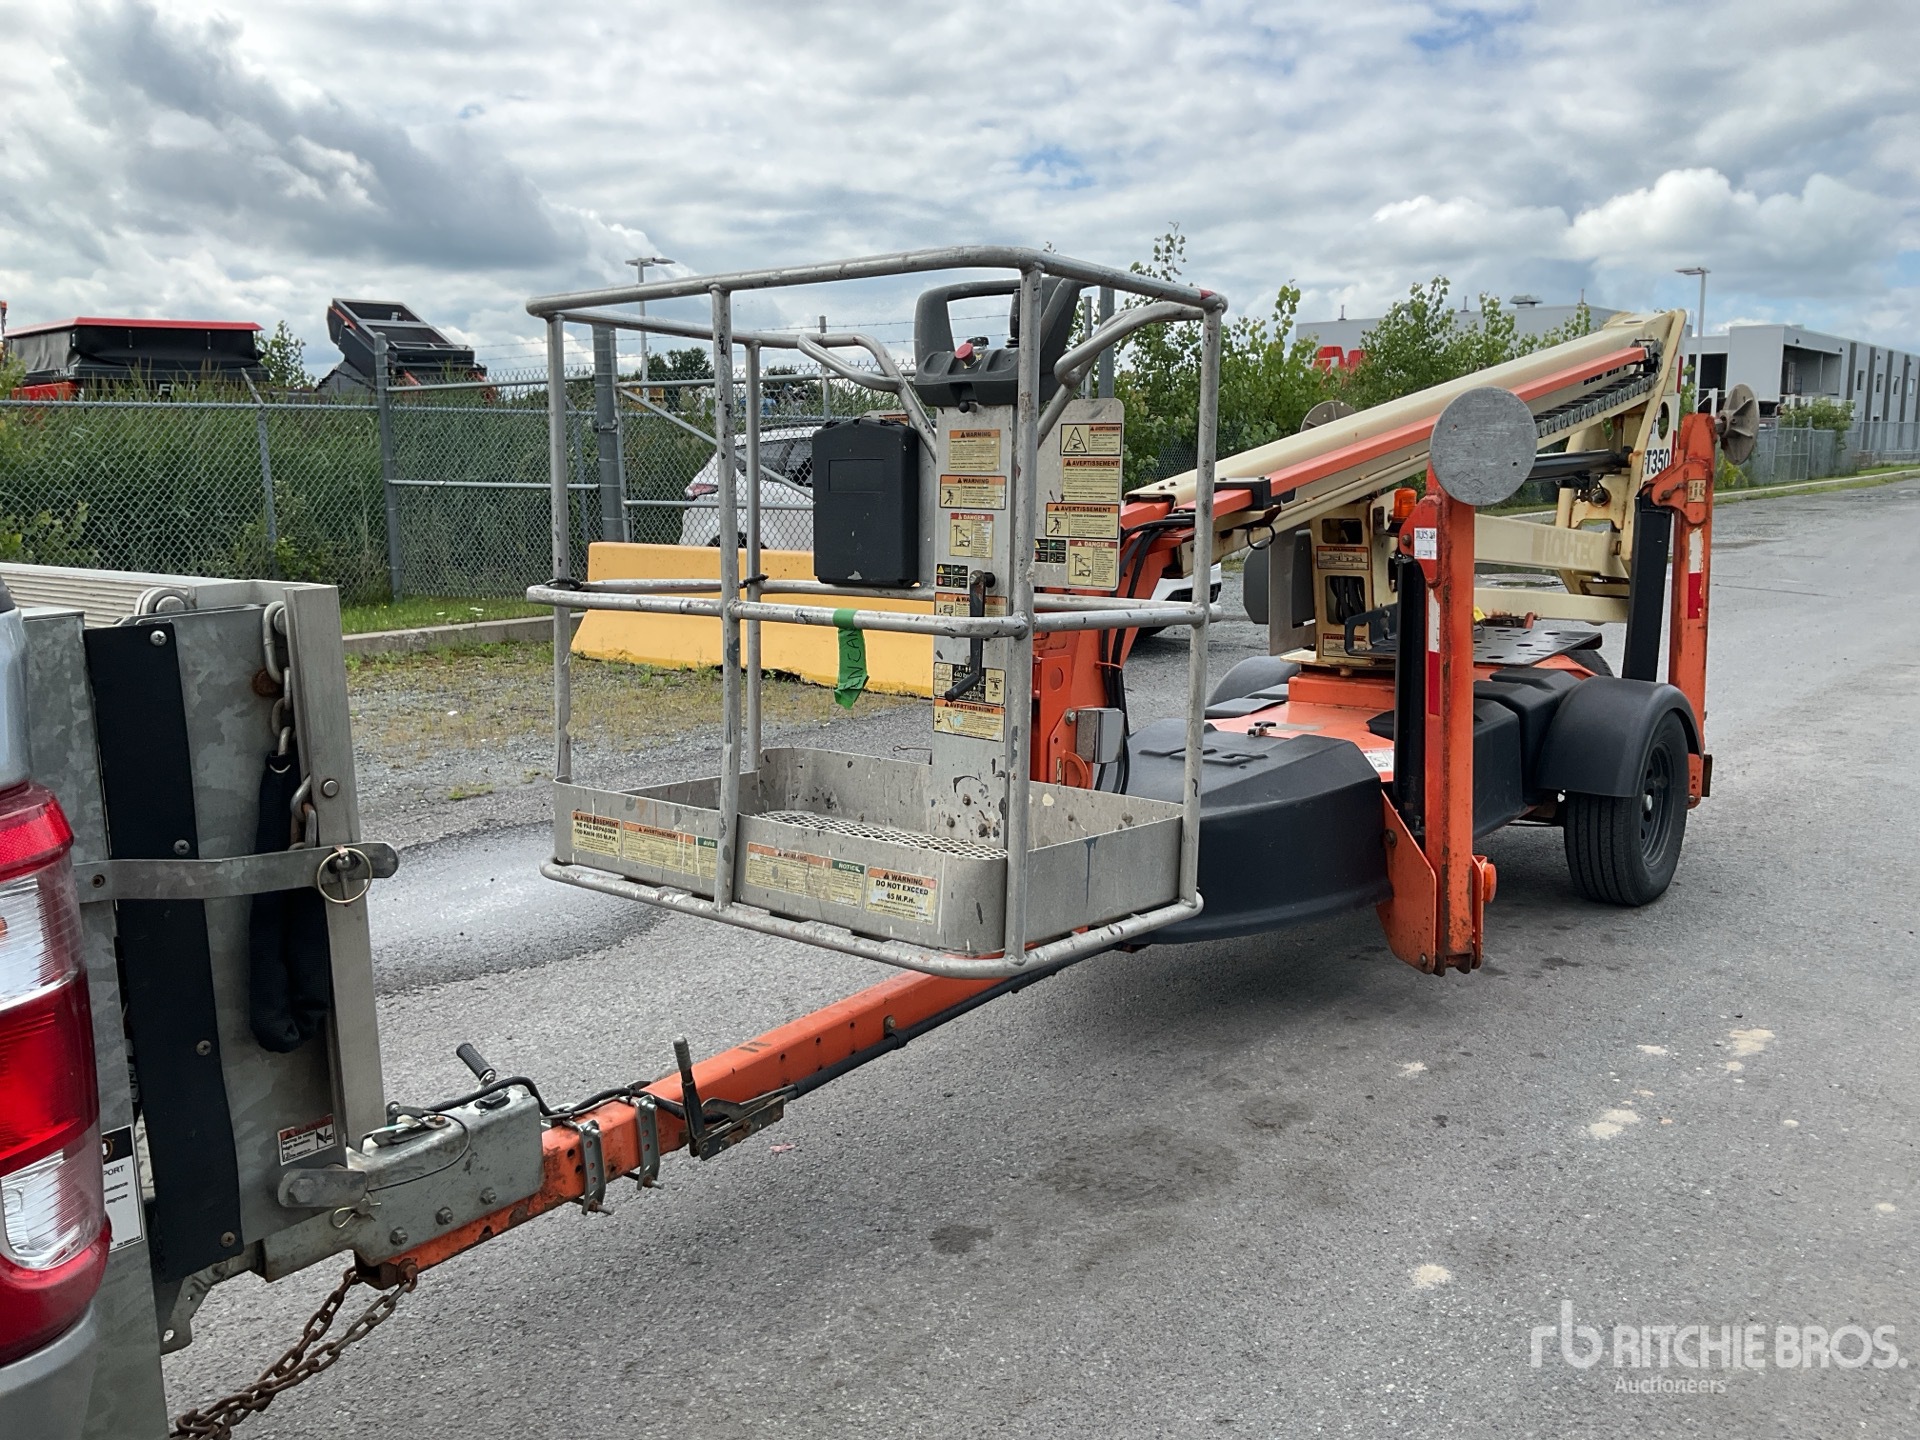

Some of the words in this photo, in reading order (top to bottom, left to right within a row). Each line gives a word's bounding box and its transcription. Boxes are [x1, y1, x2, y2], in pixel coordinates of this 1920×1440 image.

[1646, 448, 1670, 474] T350
[892, 873, 923, 886] WARNING
[887, 882, 901, 890] NOT
[903, 885, 929, 895] EXCEED
